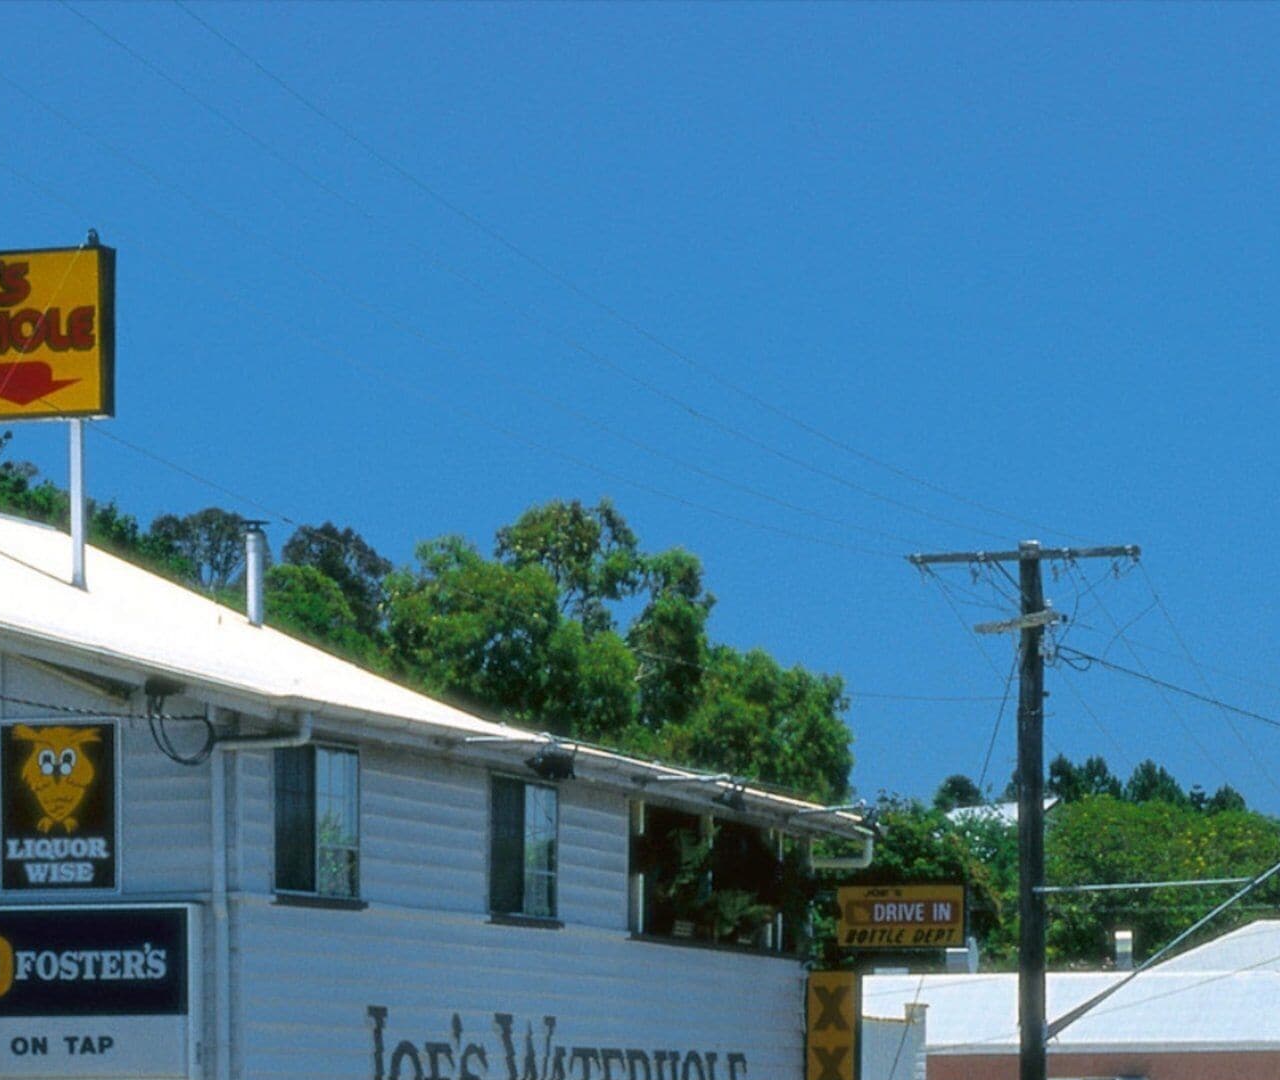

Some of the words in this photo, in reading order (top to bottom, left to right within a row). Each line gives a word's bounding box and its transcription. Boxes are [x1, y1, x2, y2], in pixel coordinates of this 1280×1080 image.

[7, 839, 110, 860] LIQUOR
[25, 862, 94, 884] WISE
[873, 903, 925, 922] DRIVE
[932, 902, 951, 921] IN
[845, 929, 905, 944] BOTTLE
[912, 928, 955, 943] DEPT
[15, 942, 167, 981] FOSTER'S
[11, 1037, 49, 1055] ON
[64, 1036, 114, 1054] TAP
